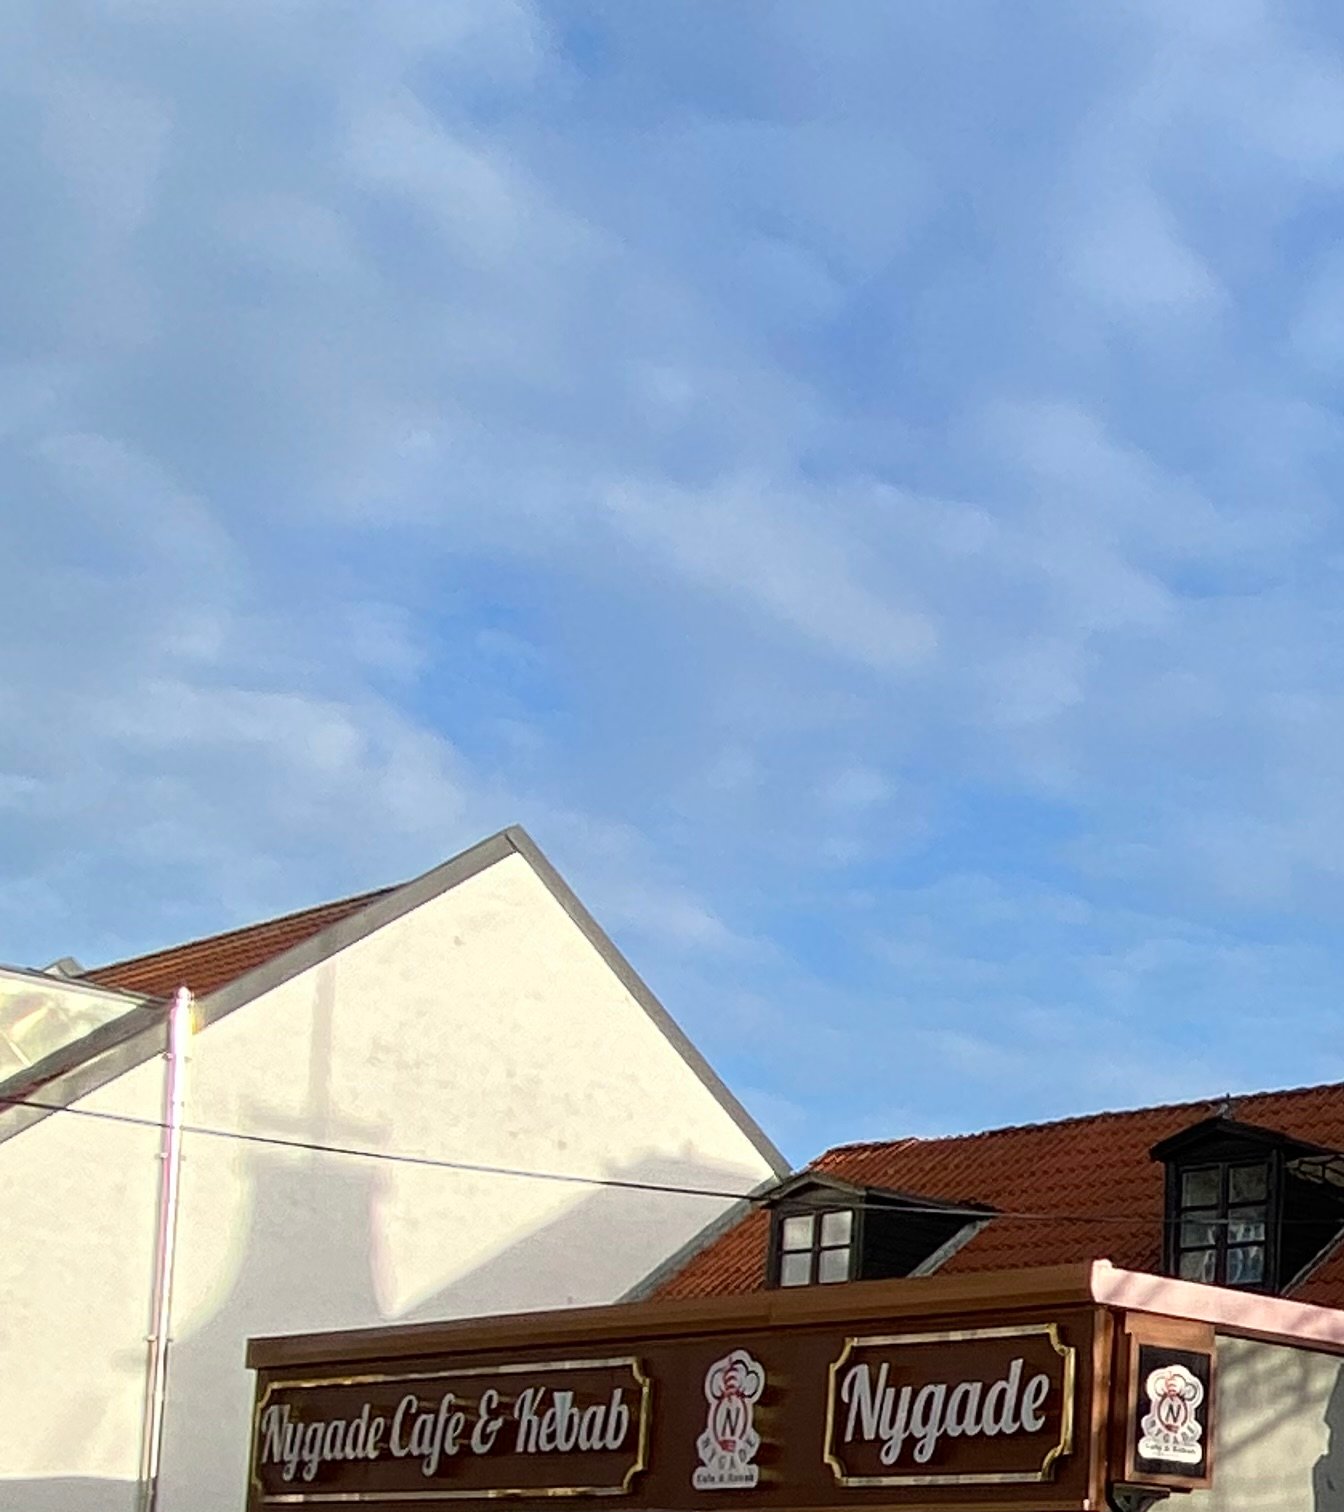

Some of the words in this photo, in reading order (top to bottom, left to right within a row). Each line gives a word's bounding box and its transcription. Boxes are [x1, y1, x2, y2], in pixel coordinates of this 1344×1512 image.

[261, 1403, 385, 1482] Nygade
[389, 1393, 465, 1478] Cafe
[471, 1389, 504, 1455] &
[514, 1386, 630, 1454] Kebab
[841, 1358, 1050, 1466] Nygade
